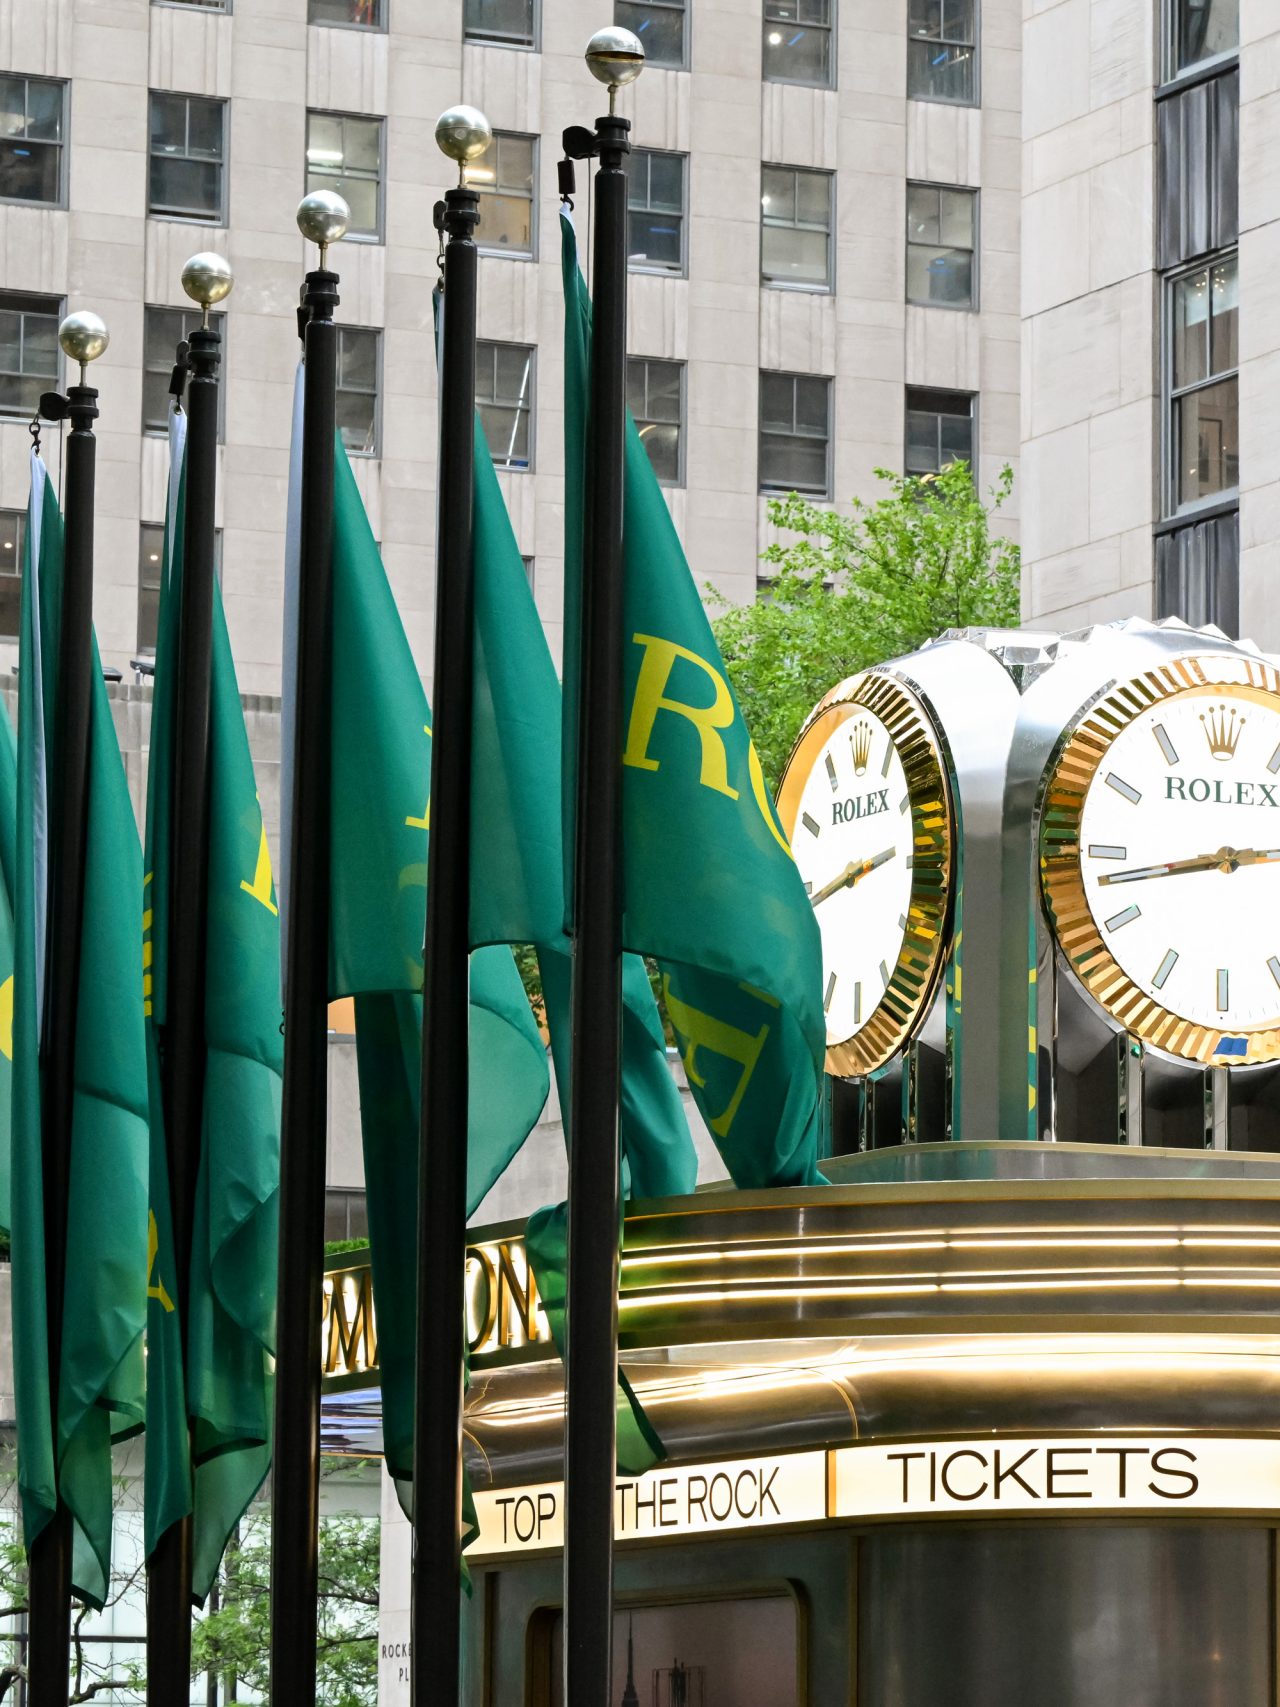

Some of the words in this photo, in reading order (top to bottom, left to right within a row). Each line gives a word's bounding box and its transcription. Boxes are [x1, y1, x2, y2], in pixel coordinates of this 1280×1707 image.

[832, 788, 890, 825] ROLEX
[1164, 776, 1280, 807] ROLEX
[887, 1448, 1199, 1503] TICKETS
[495, 1493, 557, 1544] TOP
[615, 1478, 679, 1531] THE
[687, 1466, 781, 1524] ROCK
